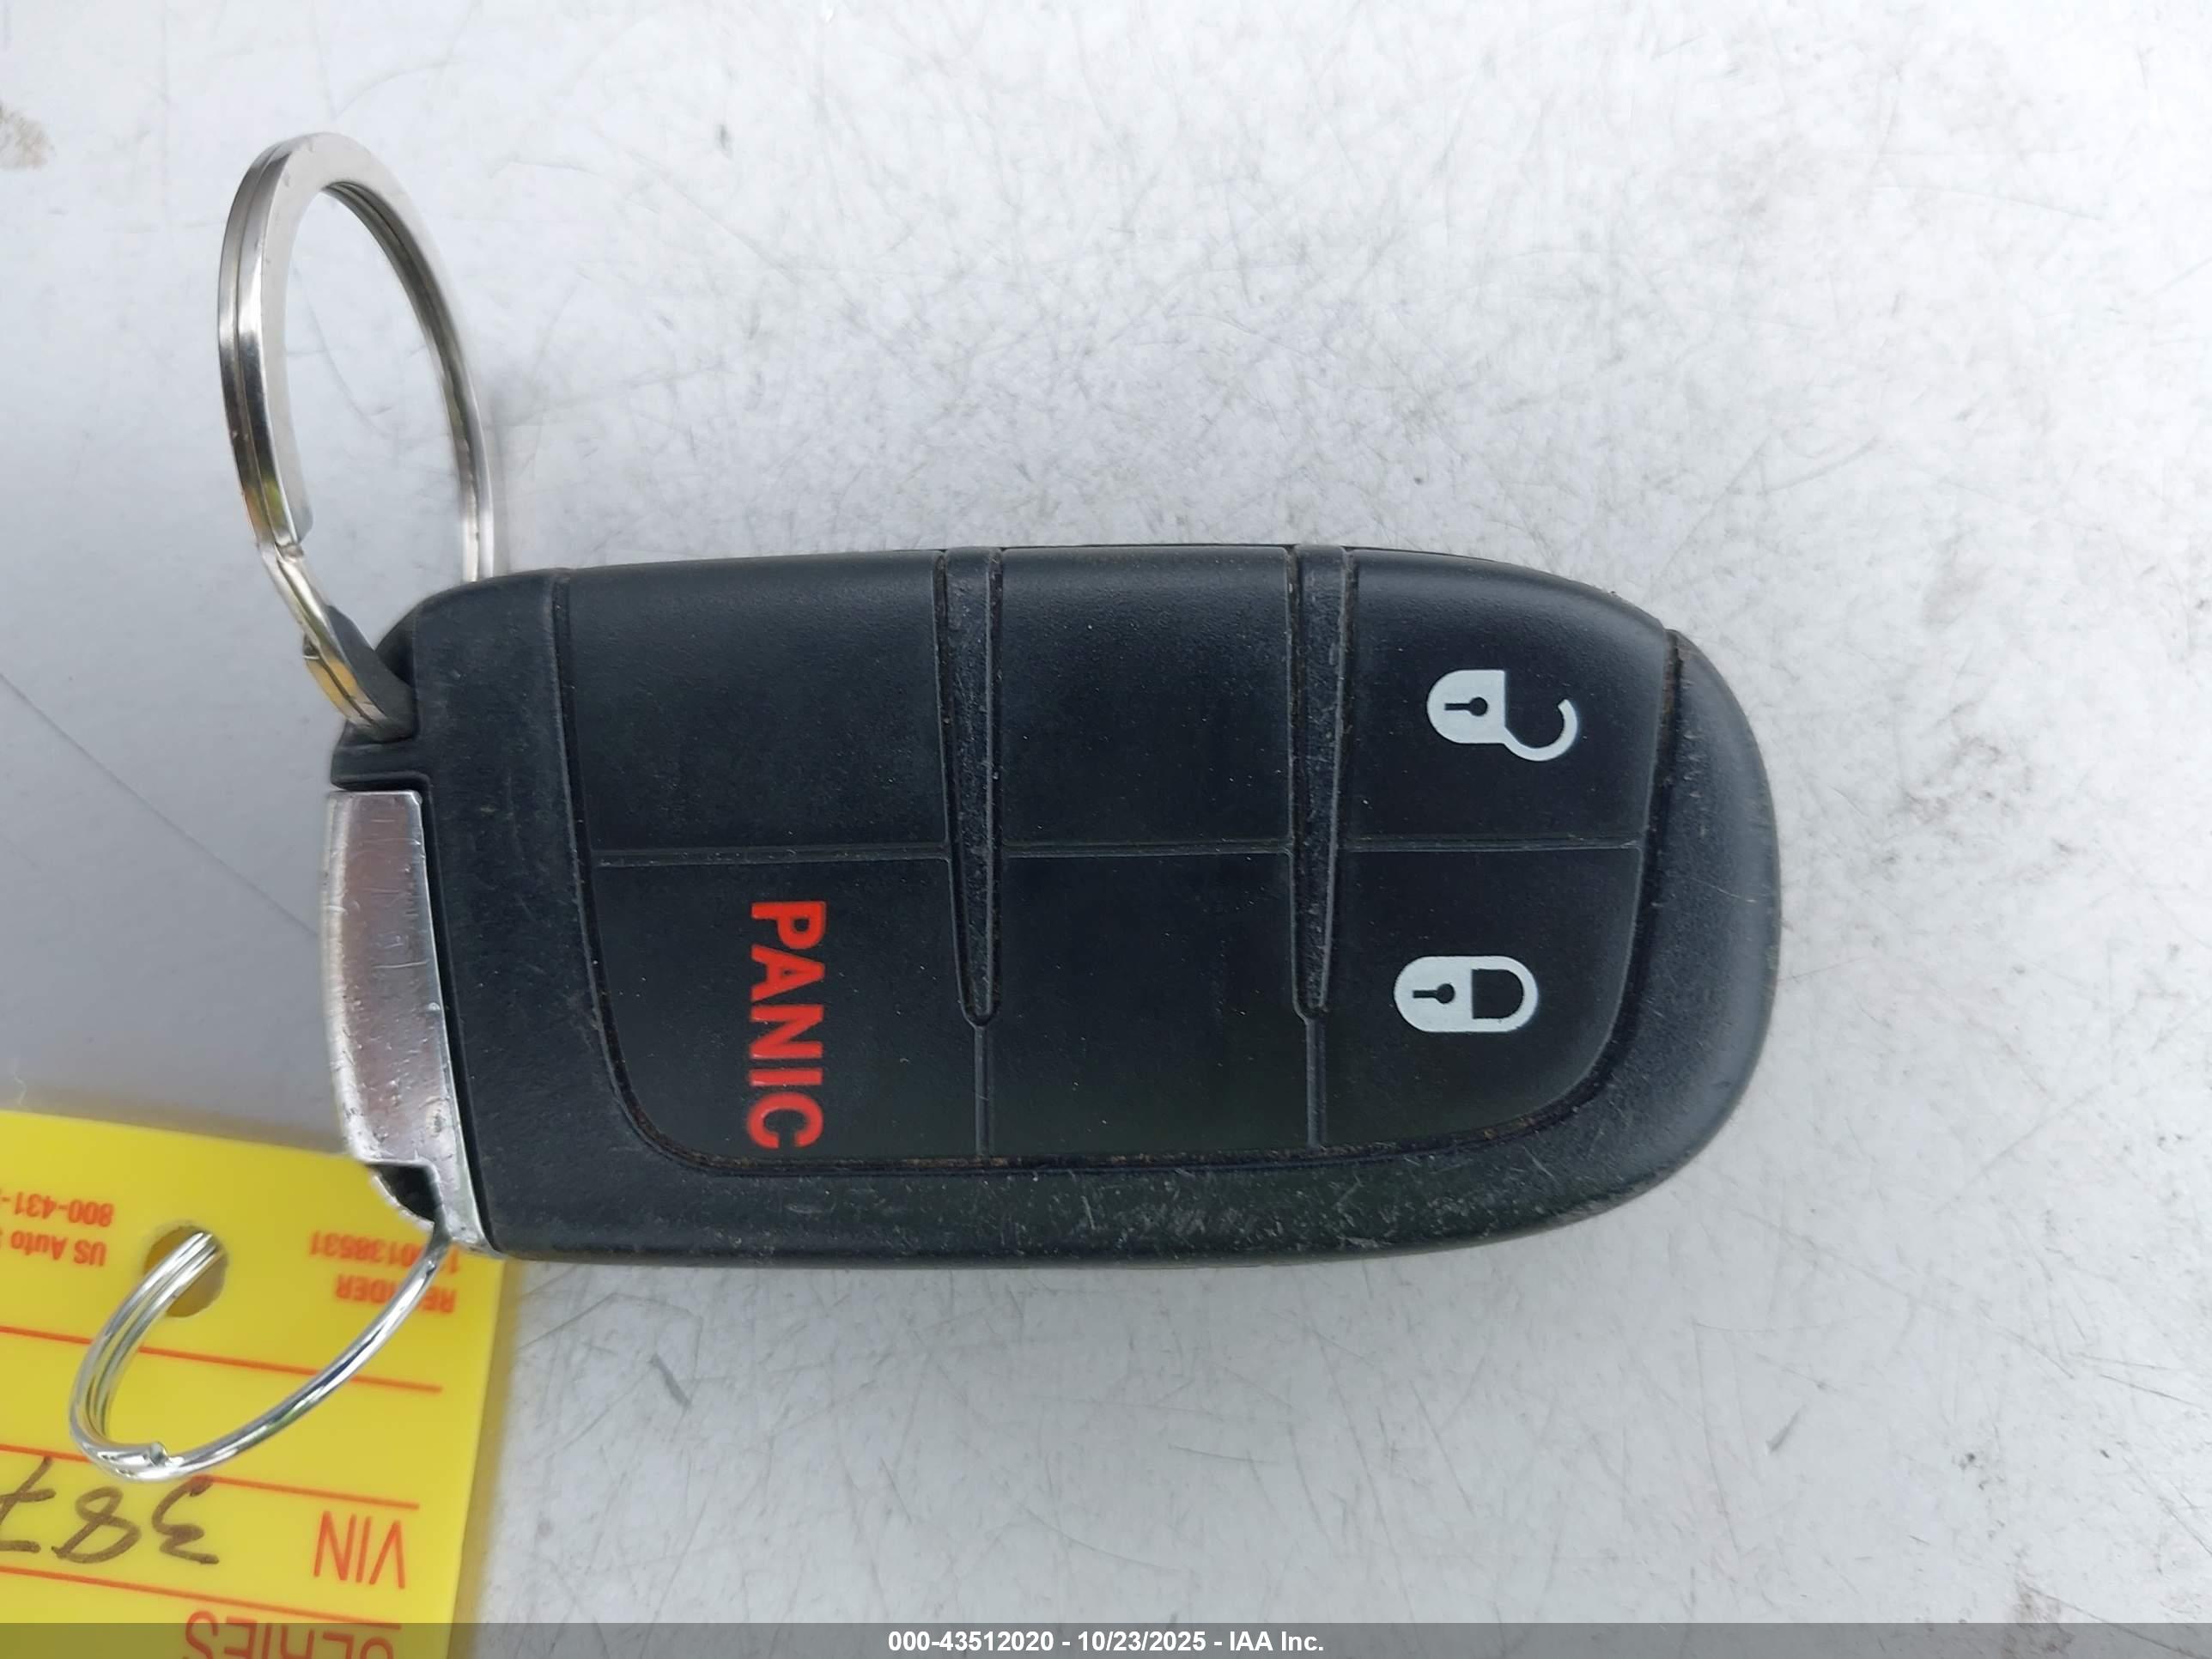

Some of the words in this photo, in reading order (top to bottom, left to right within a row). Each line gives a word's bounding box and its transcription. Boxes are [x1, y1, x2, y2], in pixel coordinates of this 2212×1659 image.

[747, 901, 826, 1149] PANIC
[0, 1189, 114, 1227] 800-431-
[10, 1231, 68, 1261] Auto
[74, 1239, 106, 1267] US
[309, 1231, 459, 1273] 10138531
[336, 1273, 457, 1313] REDER
[313, 1510, 405, 1589] VIN
